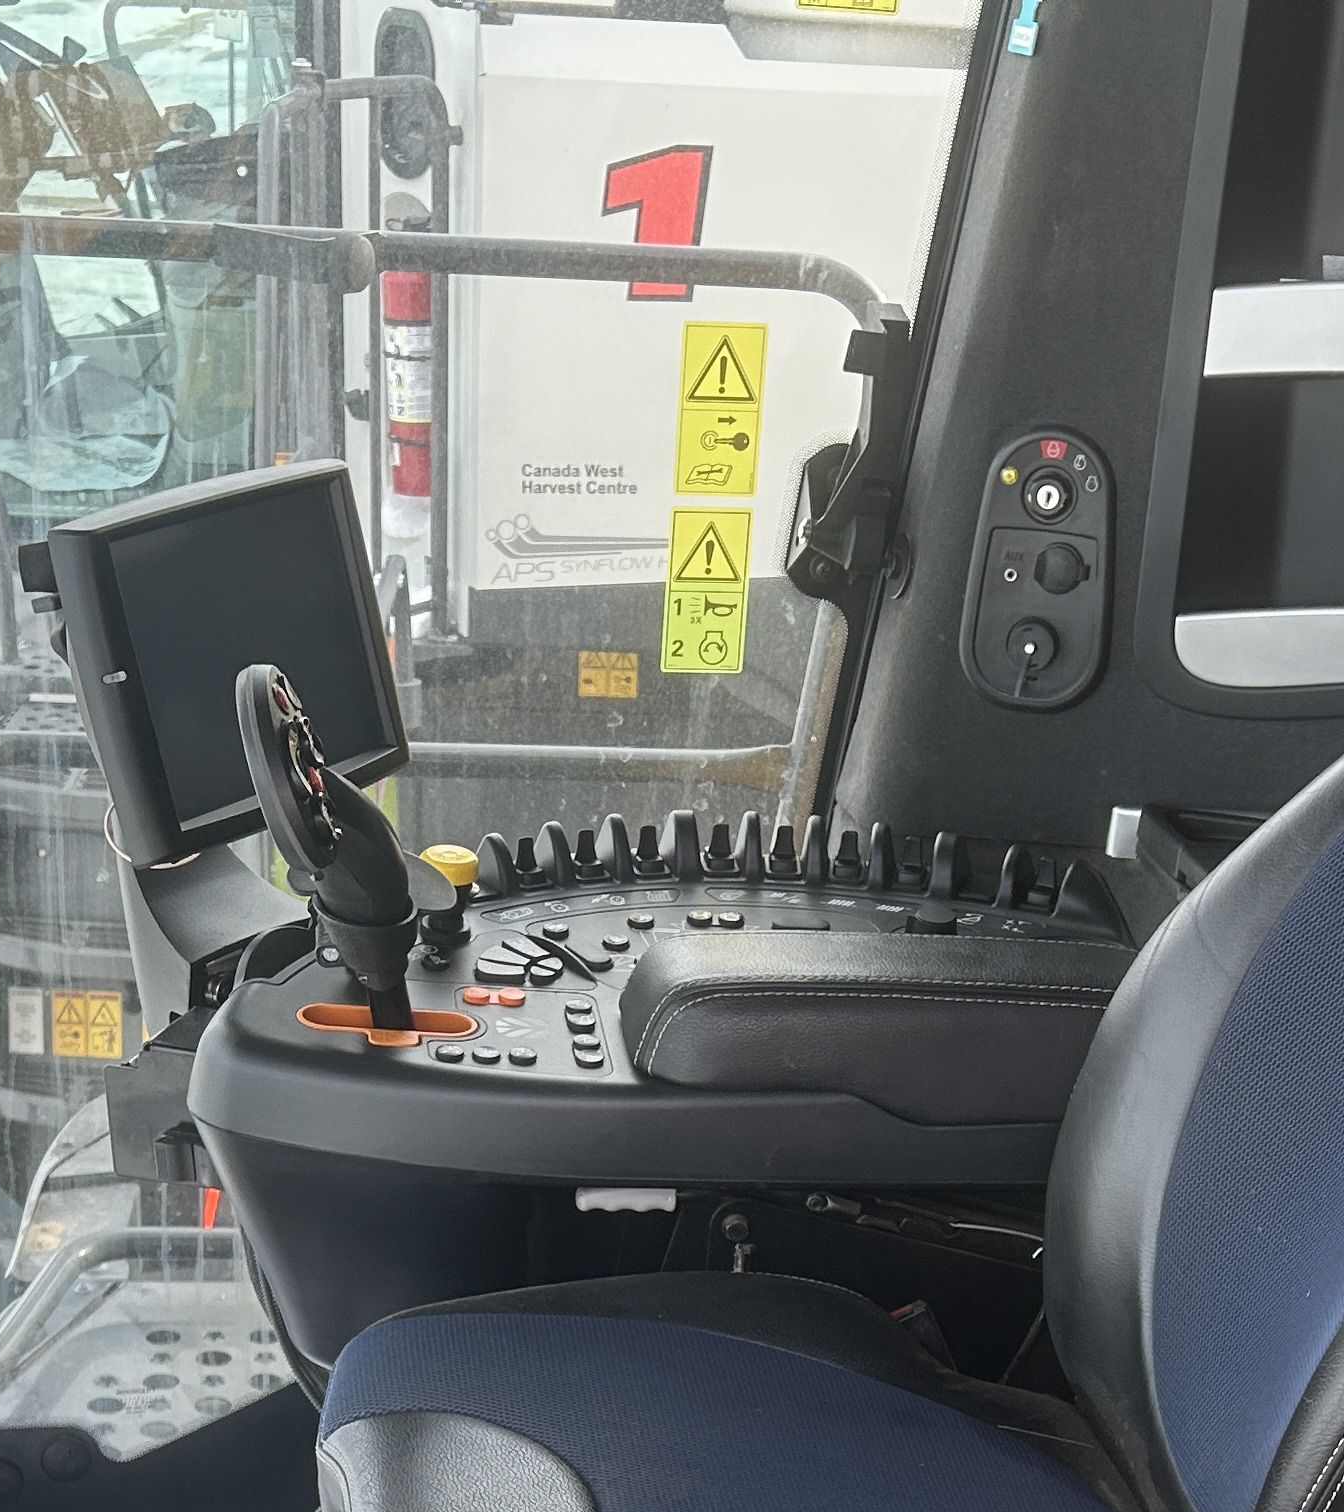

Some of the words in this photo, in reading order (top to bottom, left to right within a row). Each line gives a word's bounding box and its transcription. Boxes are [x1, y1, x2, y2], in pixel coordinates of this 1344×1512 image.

[601, 145, 713, 302] 1
[521, 463, 580, 478] Canada
[584, 463, 623, 478] West
[521, 481, 581, 495] Harvest
[586, 481, 637, 495] Centre
[1005, 551, 1024, 561] AUX
[491, 561, 557, 585] APS
[559, 556, 655, 574] SYNFLOW
[672, 598, 682, 616] 1
[689, 616, 702, 625] 3X
[670, 639, 684, 658] 2
